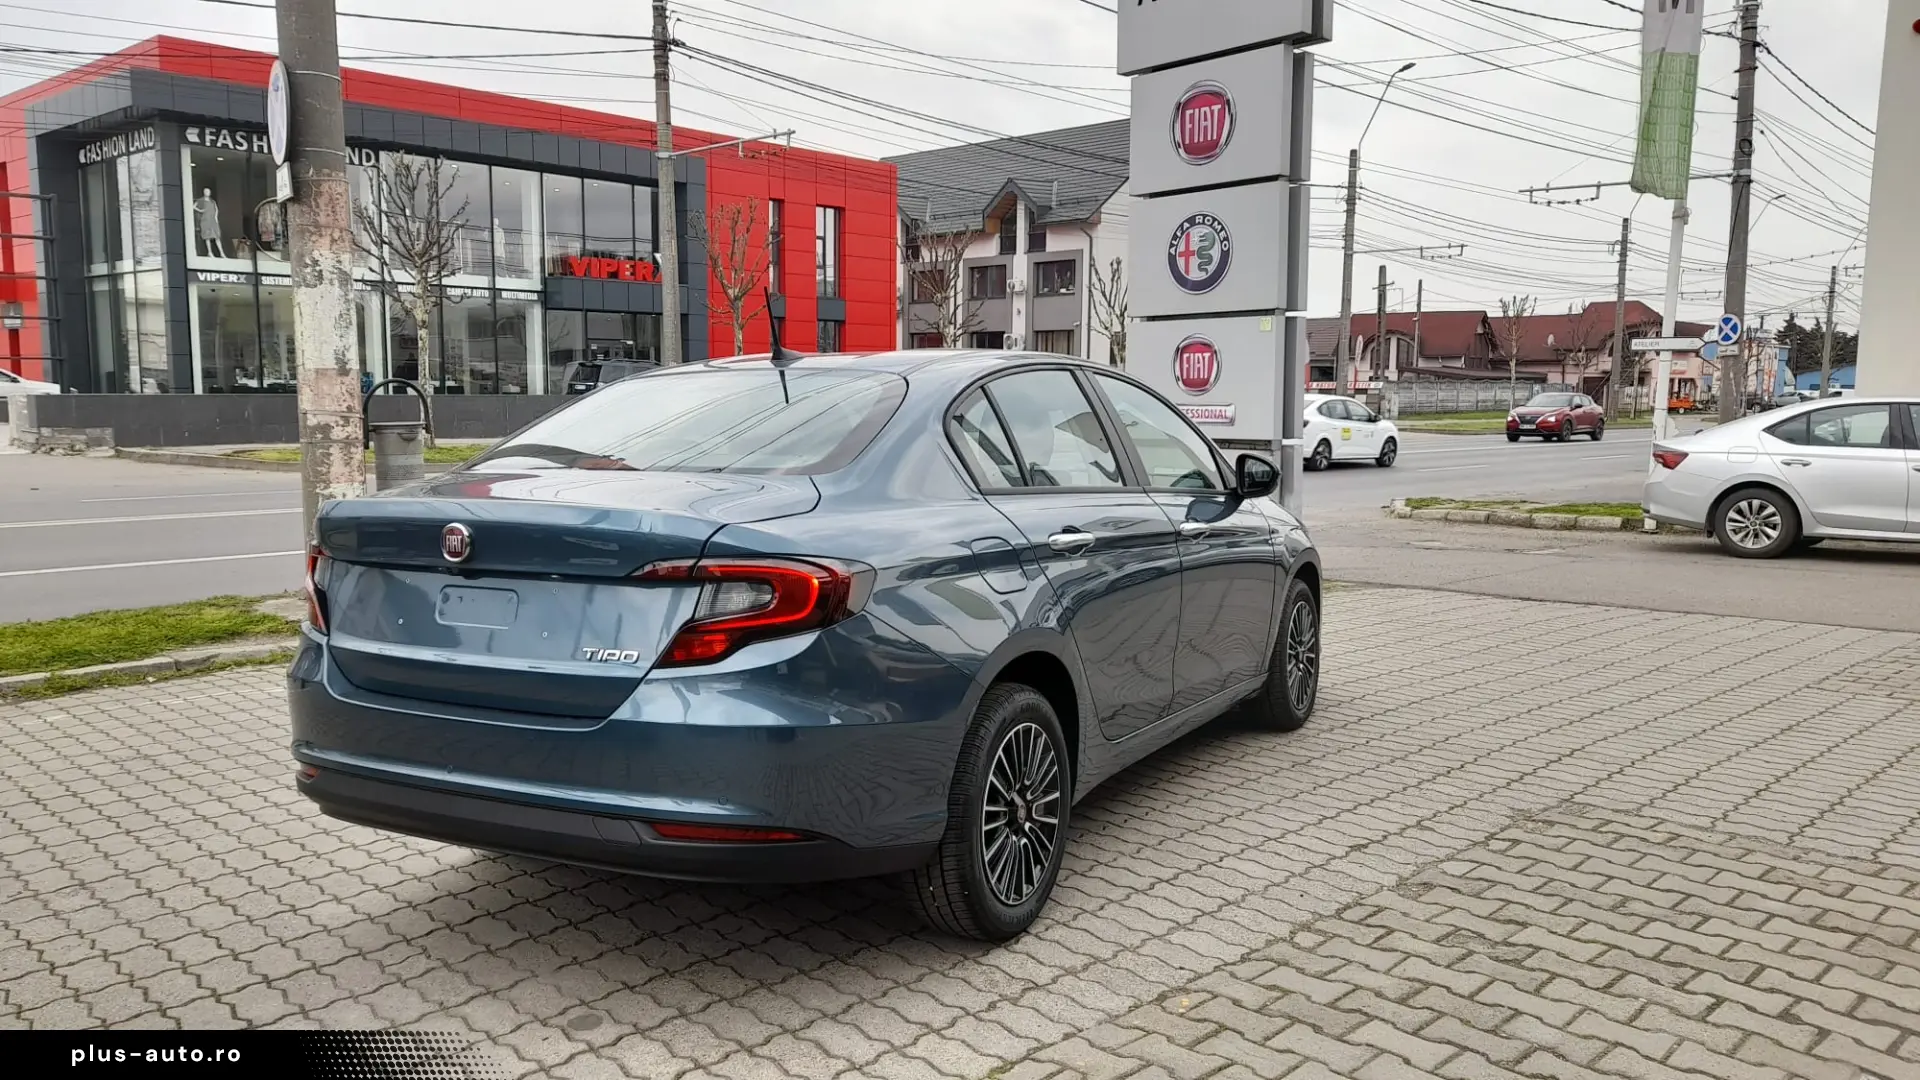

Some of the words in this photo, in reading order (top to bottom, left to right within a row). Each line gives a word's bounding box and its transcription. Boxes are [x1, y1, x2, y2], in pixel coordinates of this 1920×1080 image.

[1184, 104, 1222, 145] FIAT
[86, 134, 126, 164] FASHION
[128, 126, 155, 152] LAND
[204, 128, 269, 154] FASH
[345, 145, 375, 166] ND
[1169, 222, 1191, 255] ALFA
[1195, 215, 1230, 252] ROMEO
[196, 272, 247, 283] VIPERX
[1182, 352, 1212, 380] FIAT
[1181, 408, 1229, 420] ESSIONAL
[446, 535, 463, 553] FIAT
[582, 647, 640, 664] TIPO
